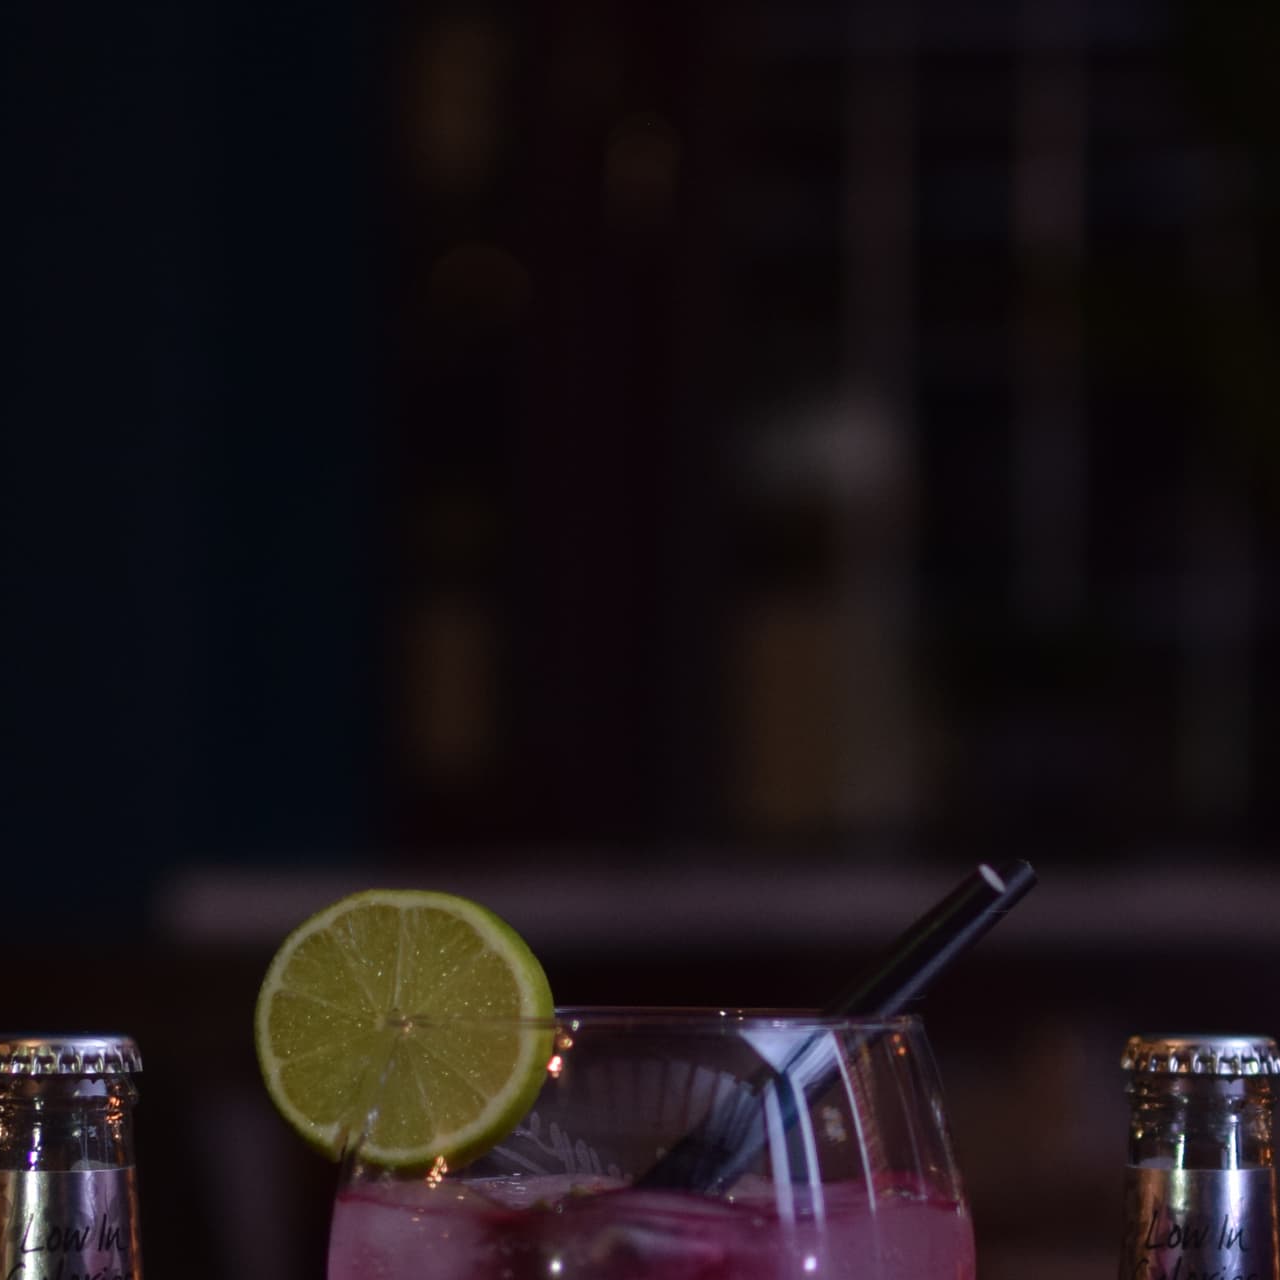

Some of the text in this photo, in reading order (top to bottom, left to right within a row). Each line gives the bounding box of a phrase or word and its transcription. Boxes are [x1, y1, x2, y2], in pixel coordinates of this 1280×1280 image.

[20, 1213, 126, 1254] Low In
[1145, 1210, 1250, 1251] Low In
